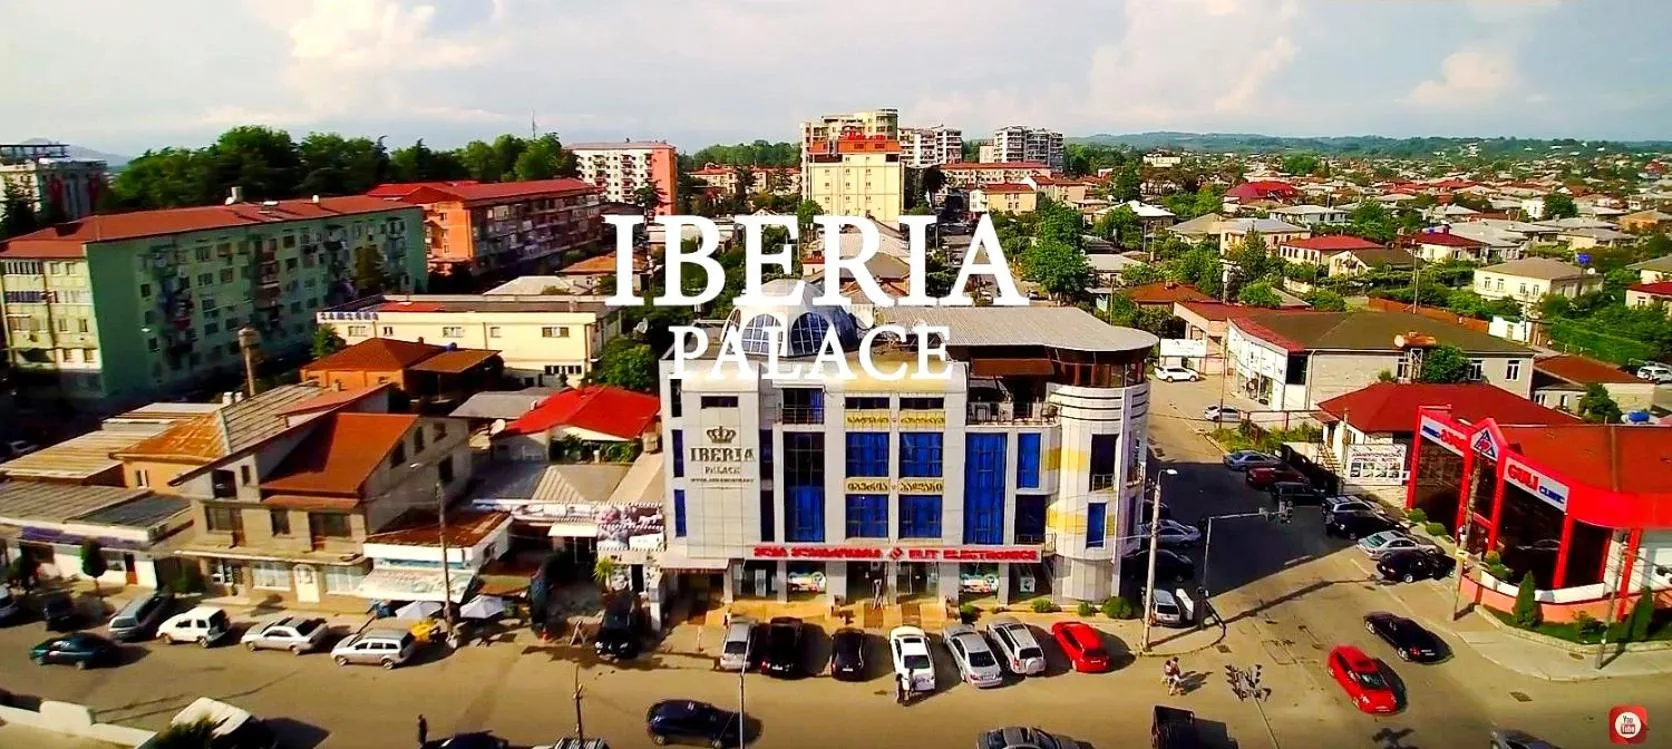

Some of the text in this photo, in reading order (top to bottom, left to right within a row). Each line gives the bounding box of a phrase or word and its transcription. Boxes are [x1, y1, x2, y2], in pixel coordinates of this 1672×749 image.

[690, 447, 756, 462] IBERIA
[1508, 464, 1539, 491] GULI
[942, 549, 1038, 560] ELECTRONICS
